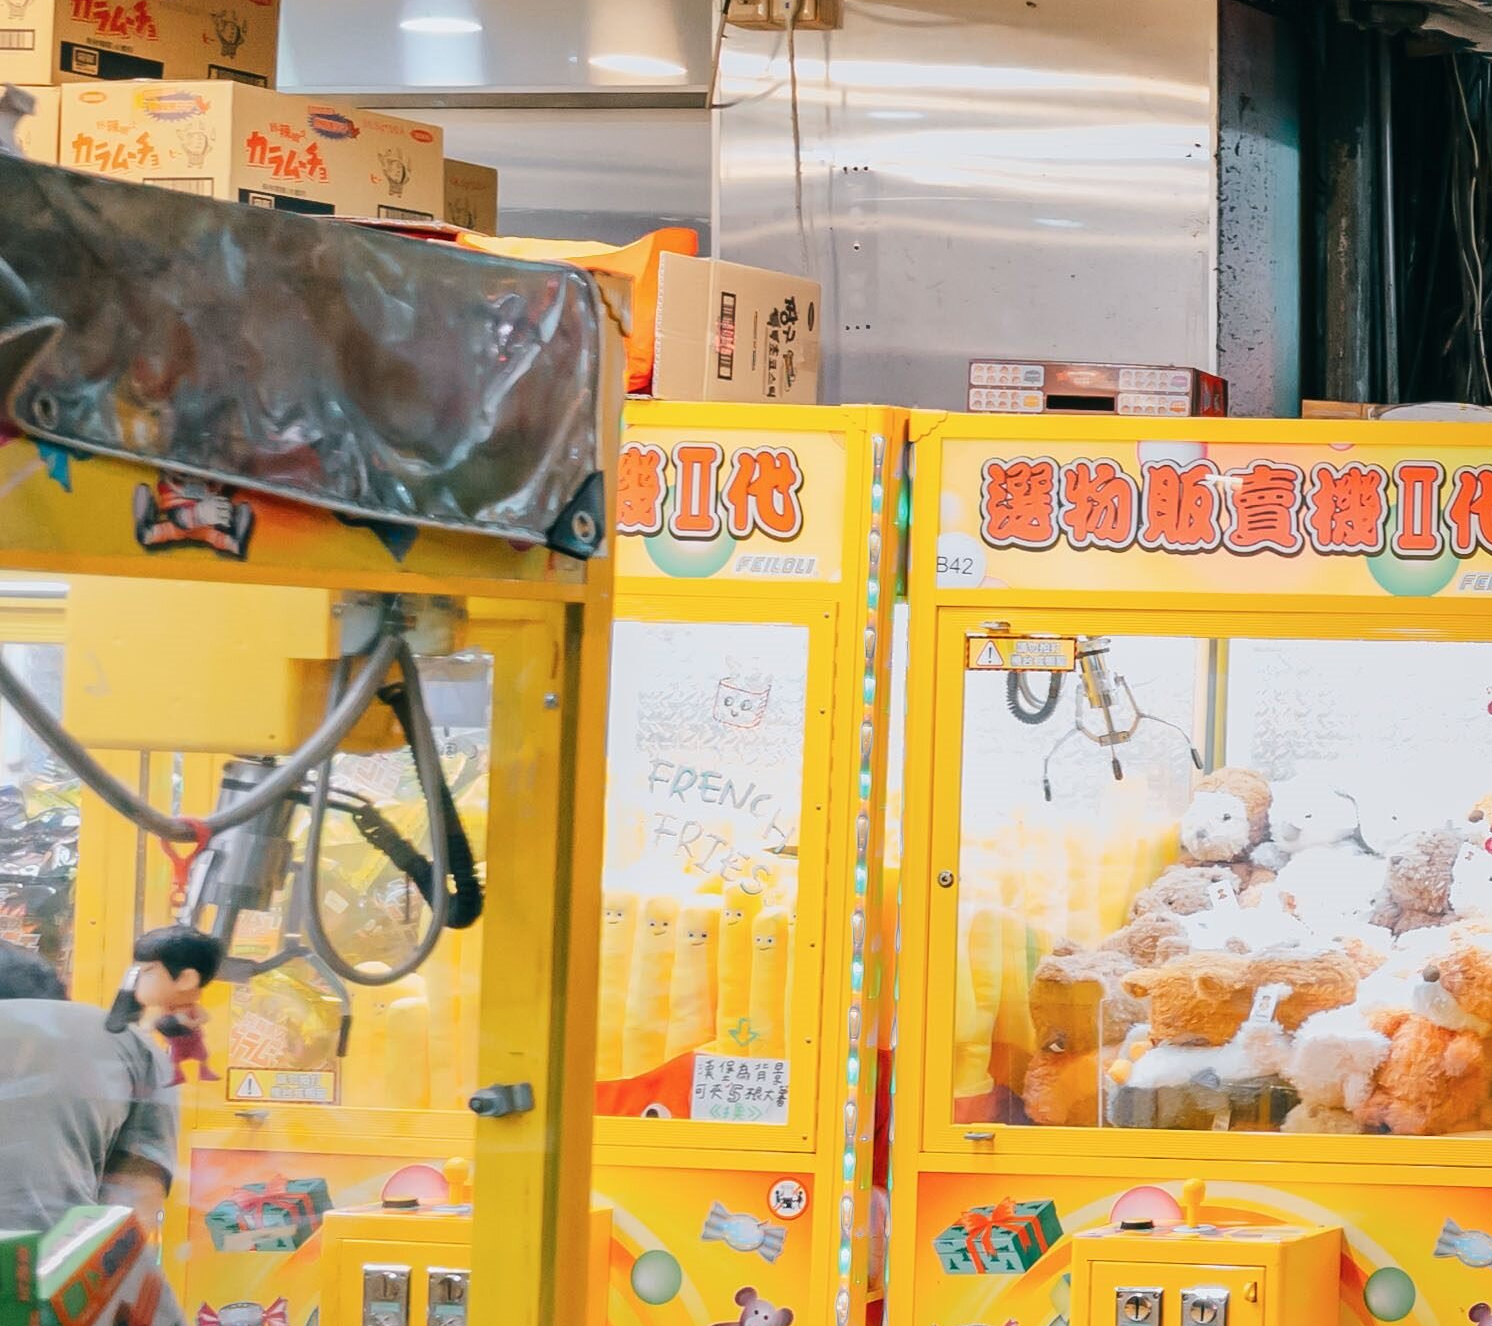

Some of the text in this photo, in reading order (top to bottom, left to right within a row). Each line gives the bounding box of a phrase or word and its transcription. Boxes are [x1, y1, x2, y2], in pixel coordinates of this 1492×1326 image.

[72, 131, 161, 173] カラムーチョ
[247, 131, 329, 182] カラムーチョ
[647, 758, 796, 854] FRENCH
[653, 813, 771, 896] FRIES
